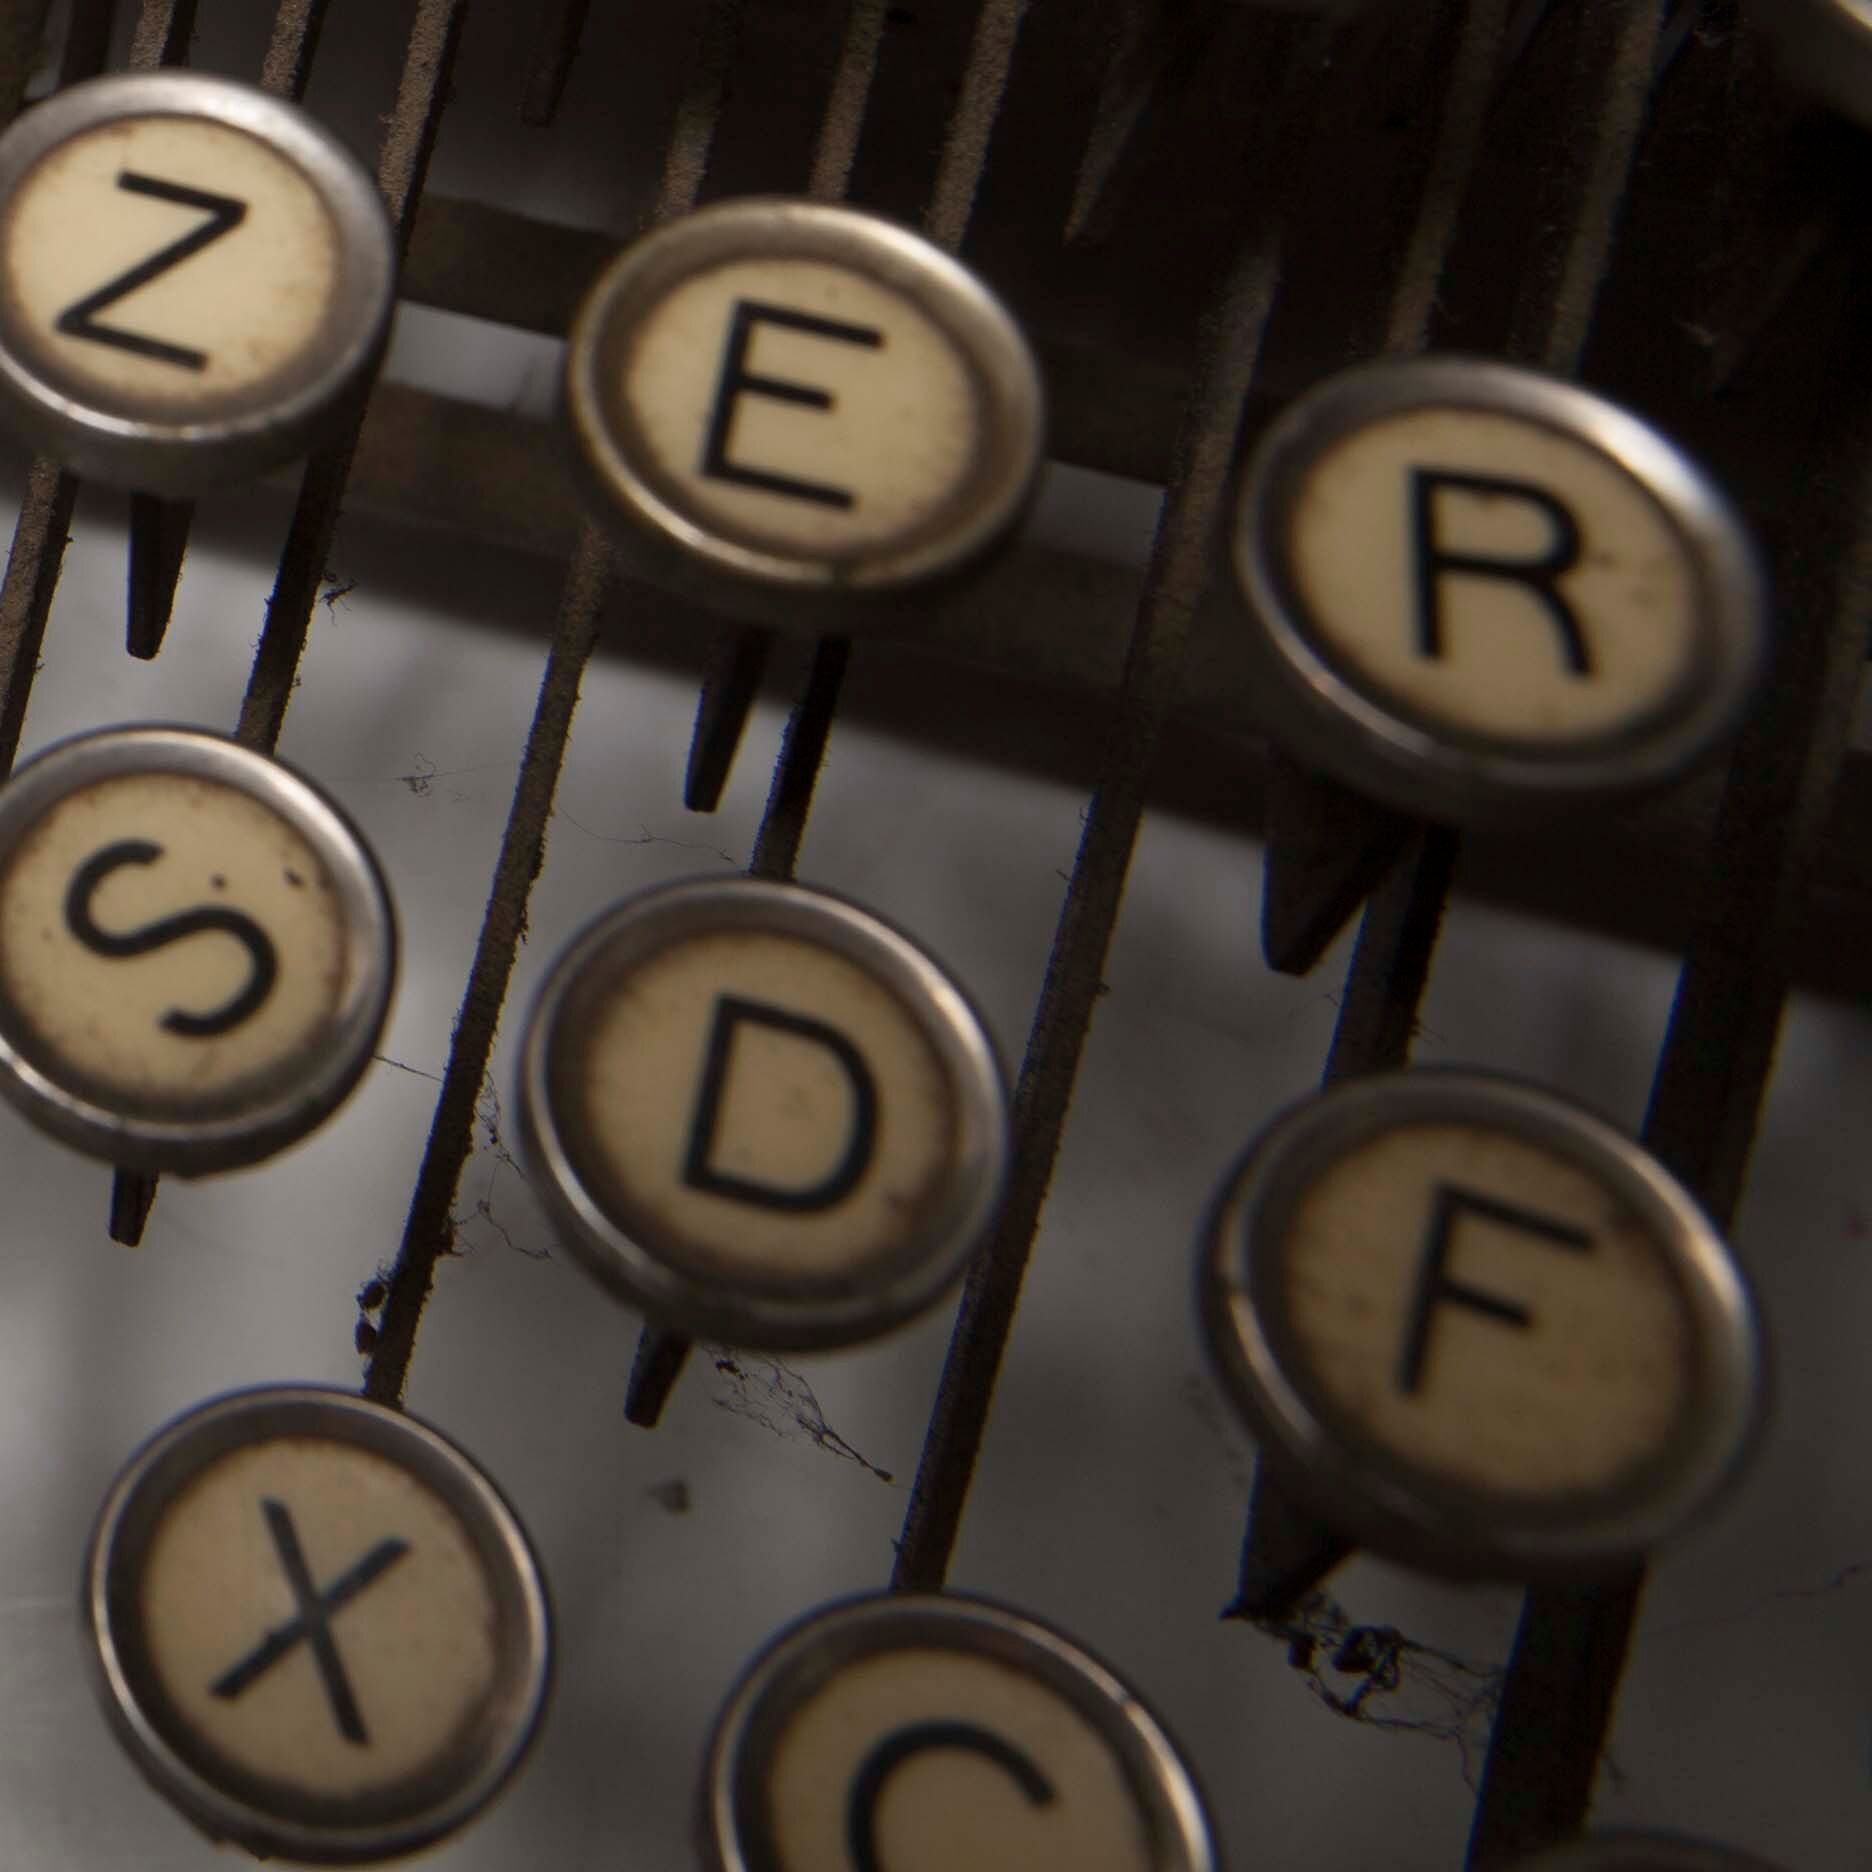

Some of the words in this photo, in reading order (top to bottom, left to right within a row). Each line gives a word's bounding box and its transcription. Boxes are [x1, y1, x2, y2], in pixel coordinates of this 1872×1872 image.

[55, 169, 250, 373] Z
[698, 297, 884, 512] E
[1406, 464, 1594, 680] R
[64, 838, 281, 1041] S
[681, 994, 880, 1213] D
[1396, 1180, 1600, 1400] F
[209, 1495, 411, 1749] X
